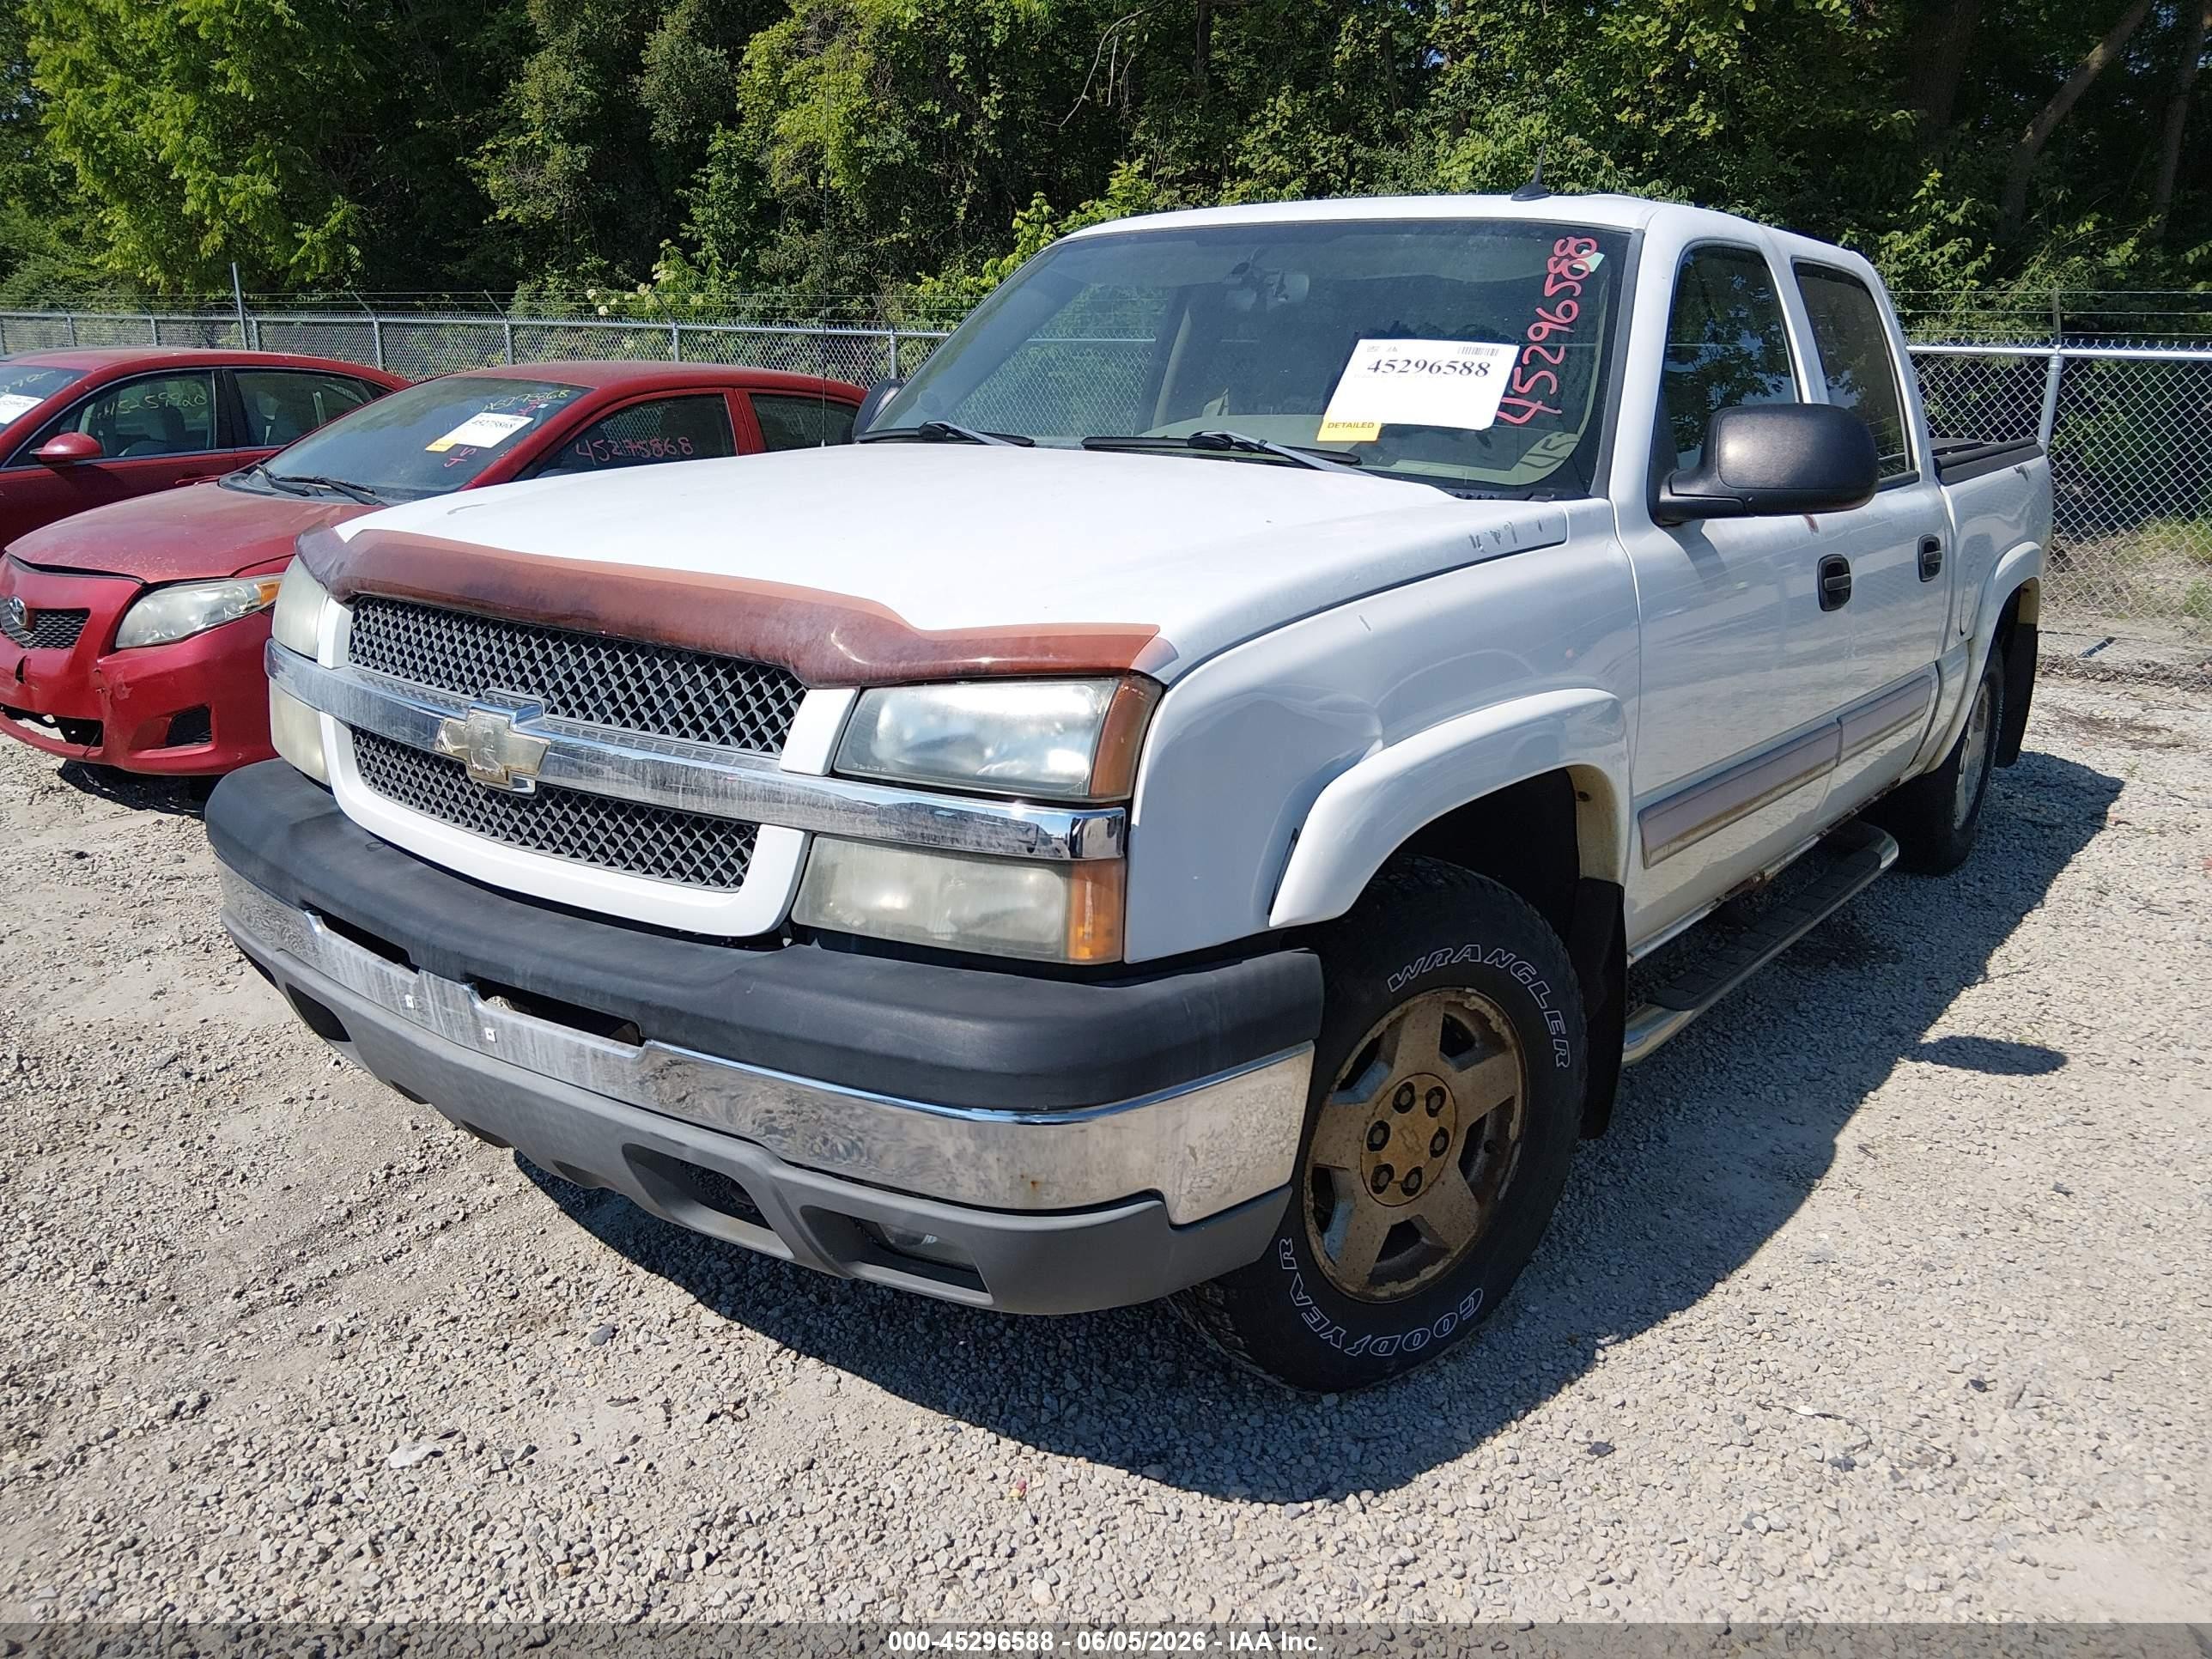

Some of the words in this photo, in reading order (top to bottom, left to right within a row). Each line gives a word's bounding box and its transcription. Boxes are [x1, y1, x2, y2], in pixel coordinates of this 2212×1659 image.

[1367, 358, 1491, 378] 45296588
[1497, 236, 1598, 424] 45296588
[1327, 421, 1375, 429] DETAILED
[1387, 944, 1571, 1068] WRANGLER
[1279, 1237, 1484, 1357] GOODYEAR
